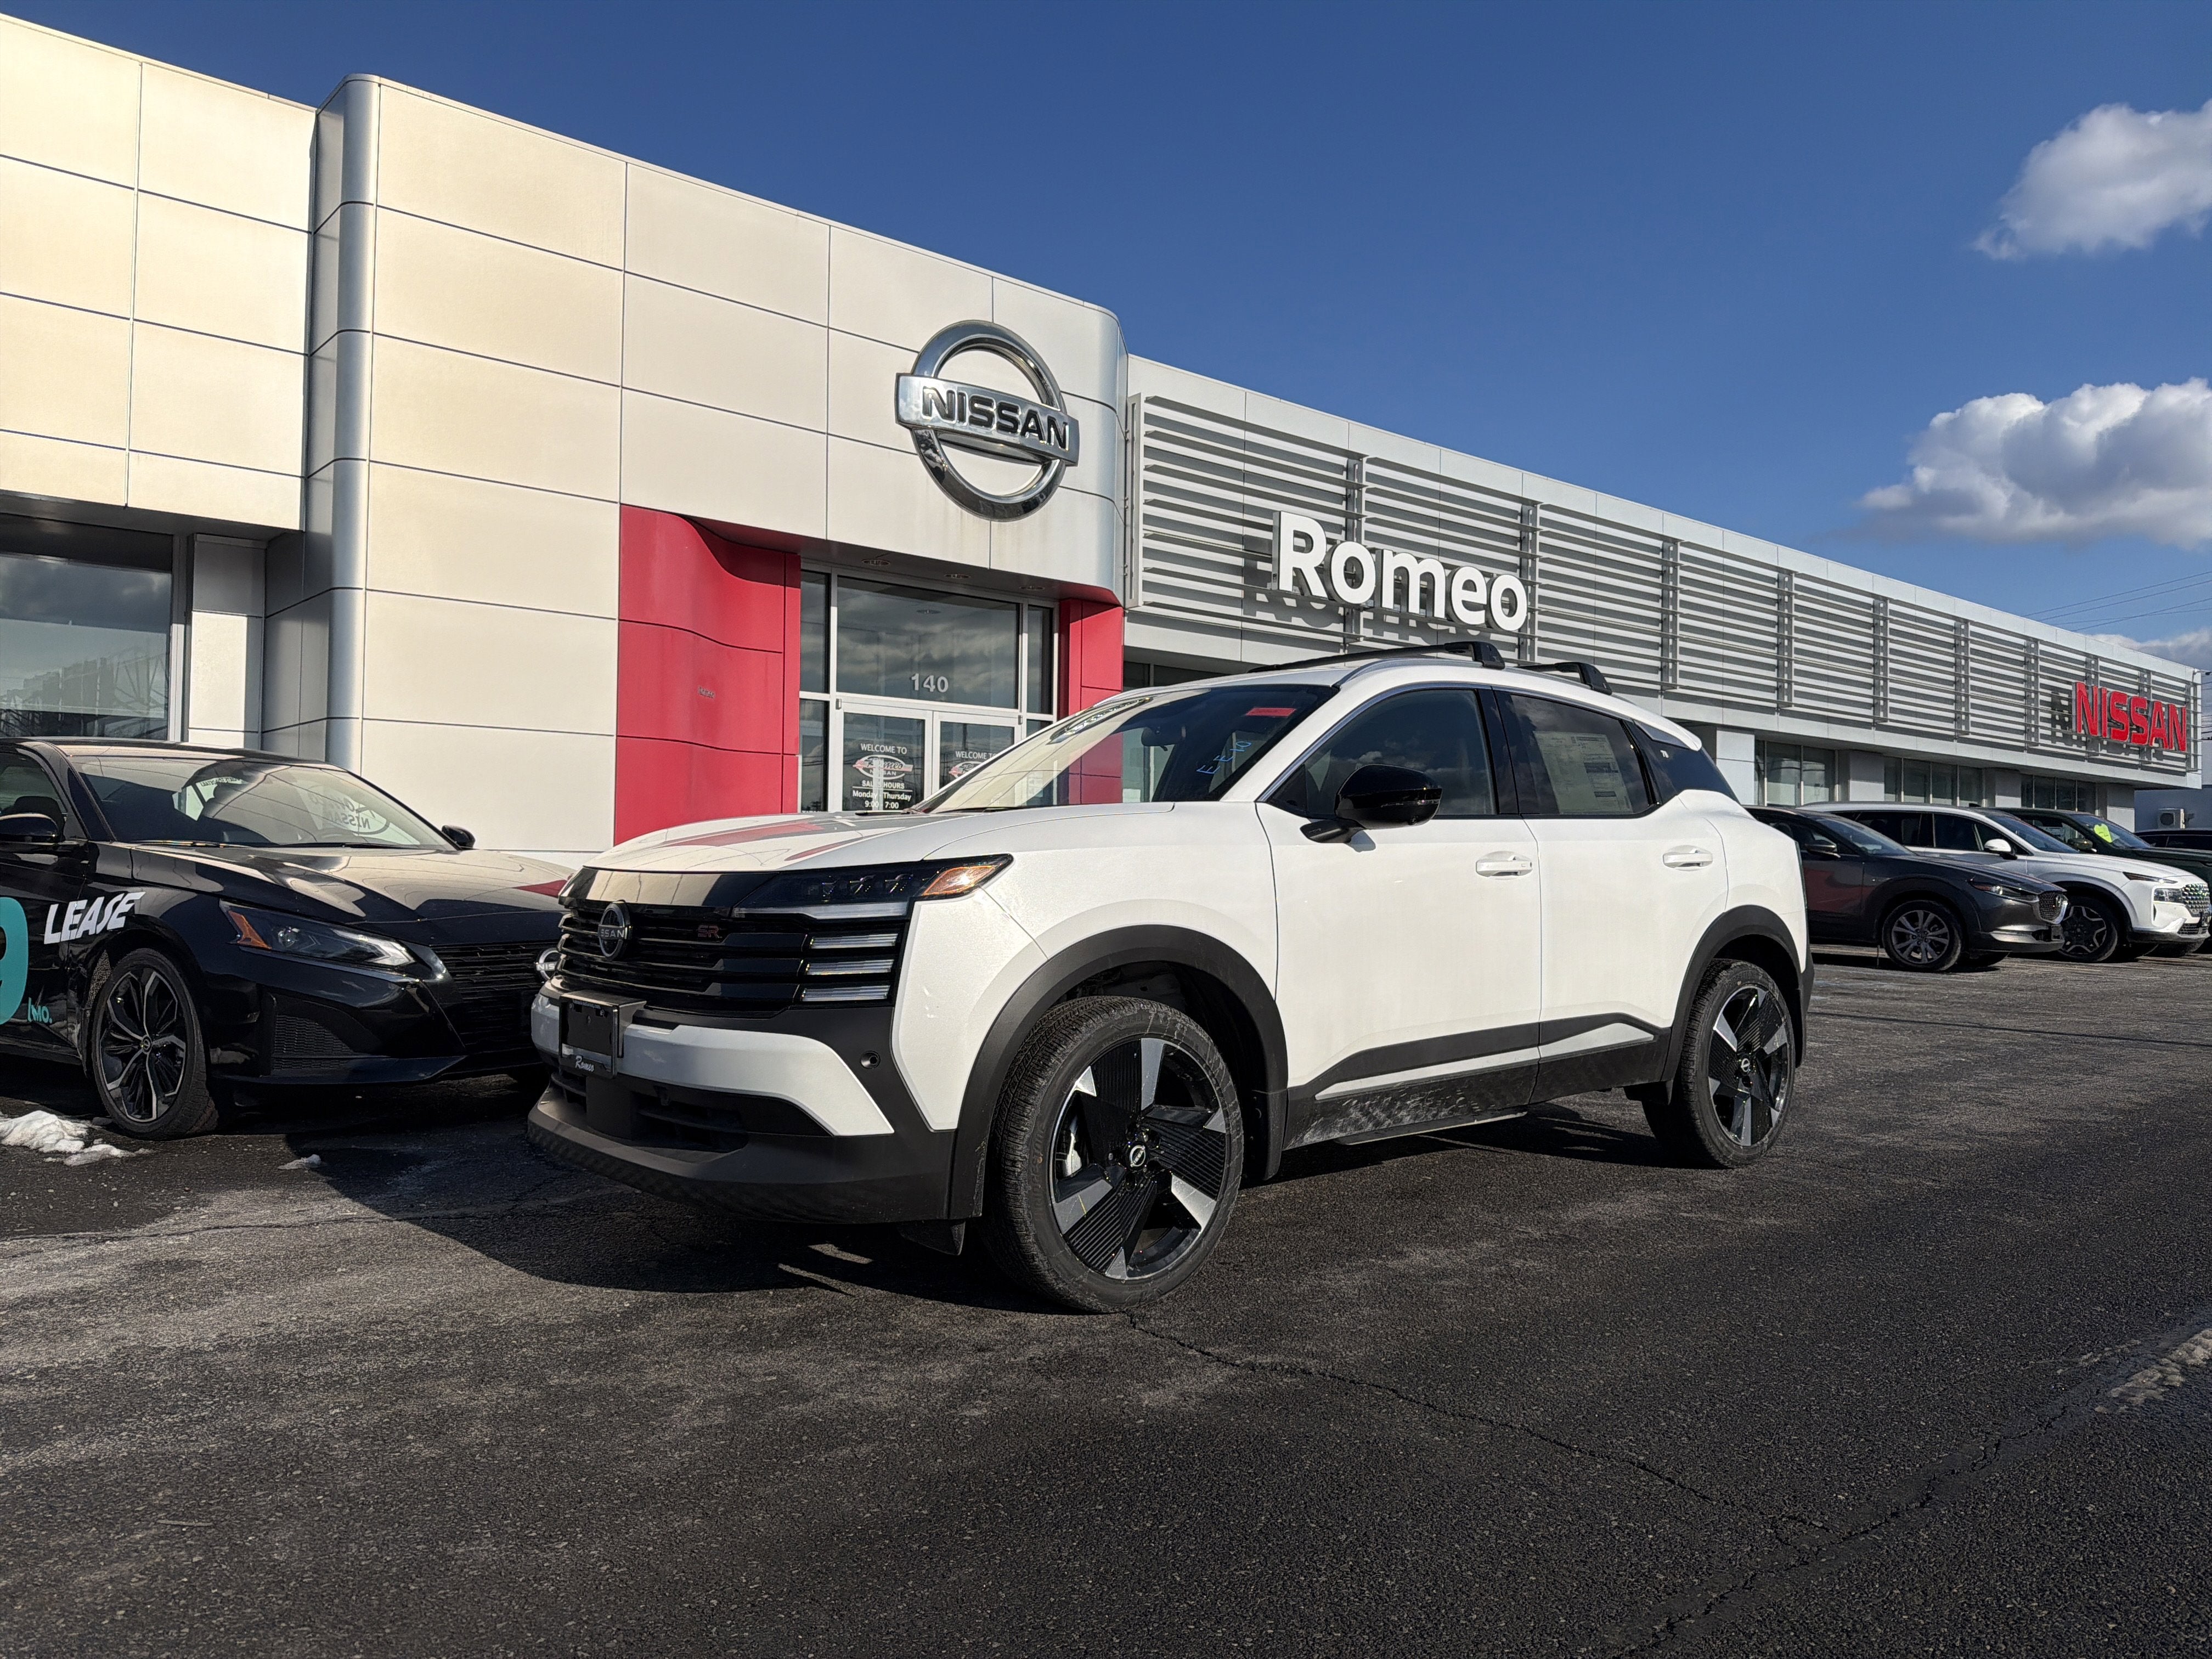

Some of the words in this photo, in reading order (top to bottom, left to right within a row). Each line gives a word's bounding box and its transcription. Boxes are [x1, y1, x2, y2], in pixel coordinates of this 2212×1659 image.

[921, 386, 1069, 452] NISSAN
[1273, 511, 1527, 631] Romeo
[911, 673, 949, 693] 140
[2075, 682, 2187, 752] NISSAN
[860, 743, 895, 754] WELCOME
[896, 746, 907, 755] TO
[955, 751, 987, 759] WELCOME
[864, 757, 904, 769] Rmeo
[862, 780, 882, 788] SALS
[853, 790, 878, 799] Monday
[883, 792, 912, 802] Thursday
[43, 891, 146, 945] LEASE
[537, 963, 556, 971] NIS
[574, 1055, 595, 1073] Romeo
